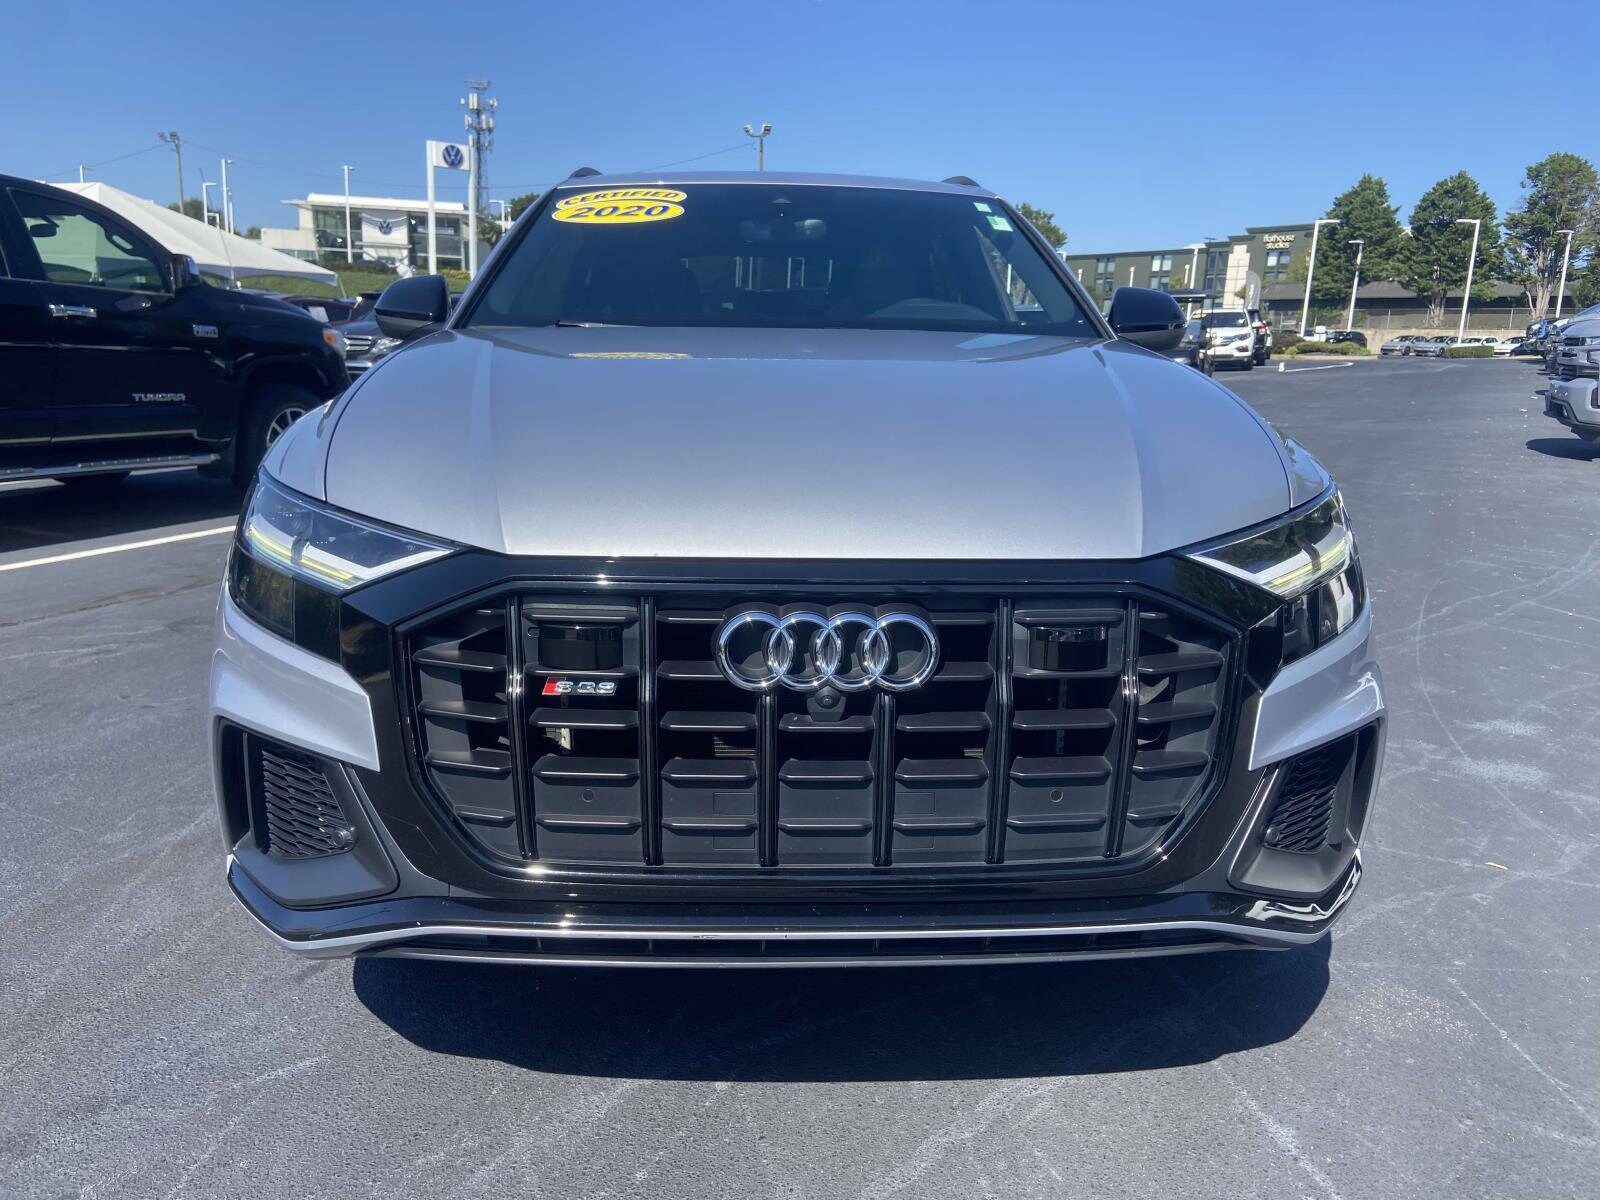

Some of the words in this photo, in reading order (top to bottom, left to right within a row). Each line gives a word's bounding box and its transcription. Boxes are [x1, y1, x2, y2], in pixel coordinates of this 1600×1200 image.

[564, 190, 679, 206] CERTIFIED
[566, 205, 670, 219] 2020
[131, 392, 187, 402] TUNDRA
[555, 680, 615, 694] SQ8
